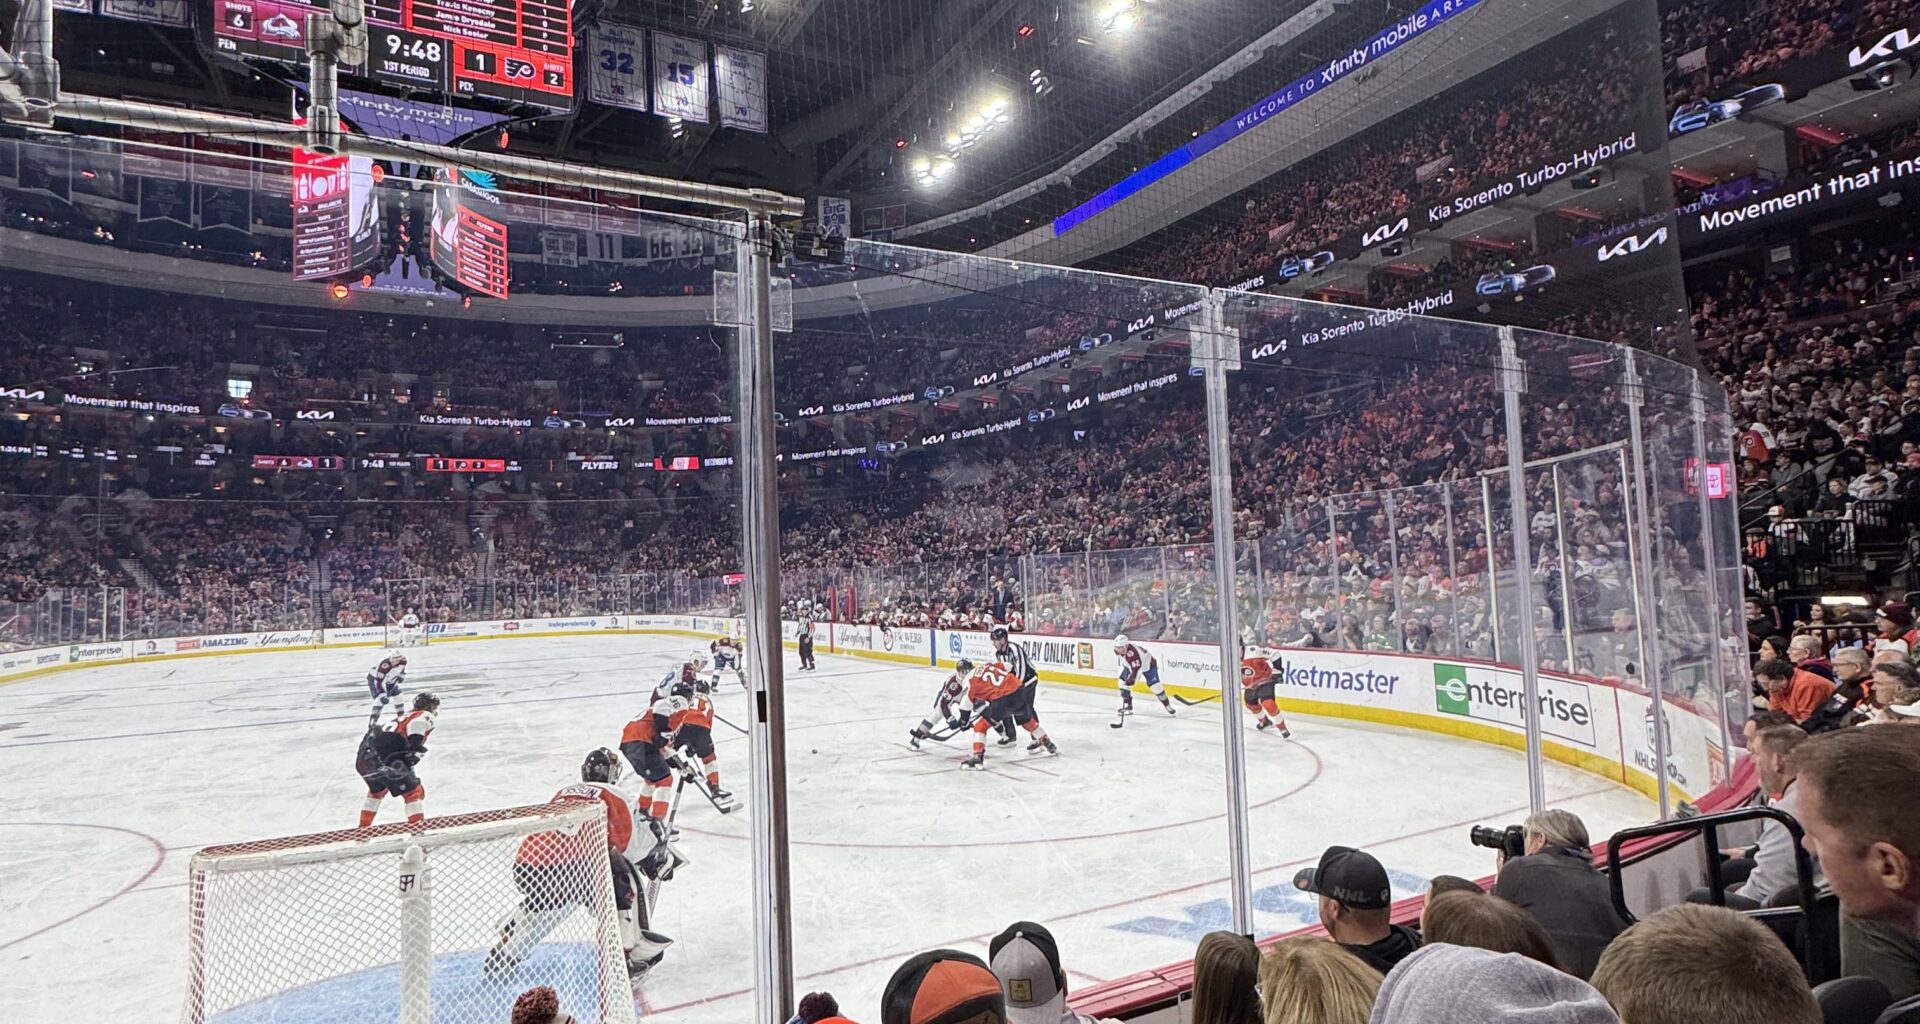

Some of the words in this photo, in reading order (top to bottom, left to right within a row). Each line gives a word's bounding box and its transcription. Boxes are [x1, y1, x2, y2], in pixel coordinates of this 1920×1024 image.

[225, 1, 252, 13] SHOTS
[436, 0, 461, 10] Travis
[233, 14, 244, 27] 6
[435, 11, 460, 22] Jamie
[461, 16, 496, 29] Drysdale
[443, 24, 462, 35] Nick
[462, 29, 489, 40] Seeler
[217, 38, 237, 50] PEN
[386, 35, 441, 62] 9:48
[383, 60, 399, 72] 1ST
[400, 64, 430, 78] PERIOD
[475, 54, 485, 71] 1
[600, 49, 634, 75] 32
[550, 73, 558, 85] 2
[667, 61, 696, 86] 15
[1237, 92, 1294, 130] WELCOME
[1300, 78, 1315, 95] TO
[1321, 45, 1369, 84] xfinity
[1372, 14, 1427, 54] mobile
[610, 85, 624, 96] 76
[338, 96, 404, 113] xfinity
[409, 107, 474, 124] mobile
[1429, 203, 1451, 222] Kia
[1454, 182, 1514, 213] Sorento
[1516, 131, 1637, 190] Turbo-Hybrid
[1700, 184, 1822, 233] Movement
[1828, 165, 1881, 195] that
[823, 203, 846, 216] BIG
[1301, 332, 1320, 346] Kia
[1321, 320, 1366, 341] Sorento
[1367, 290, 1454, 328] Turbo-Hybrid
[1003, 368, 1013, 378] Kia
[1013, 360, 1033, 375] Sorento
[1033, 345, 1072, 367] Turbo-Hybrid
[1097, 386, 1132, 402] Movement
[1133, 379, 1148, 393] that
[1149, 372, 1178, 388] inspires
[64, 393, 128, 408] Movement
[130, 399, 154, 411] that
[156, 402, 201, 416] inspires
[833, 404, 845, 413] Kia
[846, 400, 872, 411] Sorento
[872, 392, 915, 407] Turbo-Hybrid
[420, 414, 435, 425] Kia
[436, 415, 472, 426] Sorento
[473, 416, 532, 428] Turbo-Hybrid
[645, 417, 687, 426] Movement
[687, 415, 703, 425] that
[704, 414, 732, 425] inspires
[962, 426, 986, 438] Sorento
[986, 417, 1021, 433] Turbo-Hybrid
[791, 450, 826, 461] Movement
[827, 448, 840, 458] that
[841, 446, 867, 457] inspires
[324, 458, 330, 468] 1
[361, 459, 385, 469] 9:48
[438, 460, 444, 469] 1
[581, 461, 619, 470] FLYERS
[201, 636, 249, 649] AMAZING
[254, 632, 313, 648] Yuengling
[1022, 640, 1042, 663] PLAY
[1043, 641, 1076, 665] ONLINE
[1285, 660, 1400, 695] ketmaster
[1332, 885, 1368, 904] NHL
